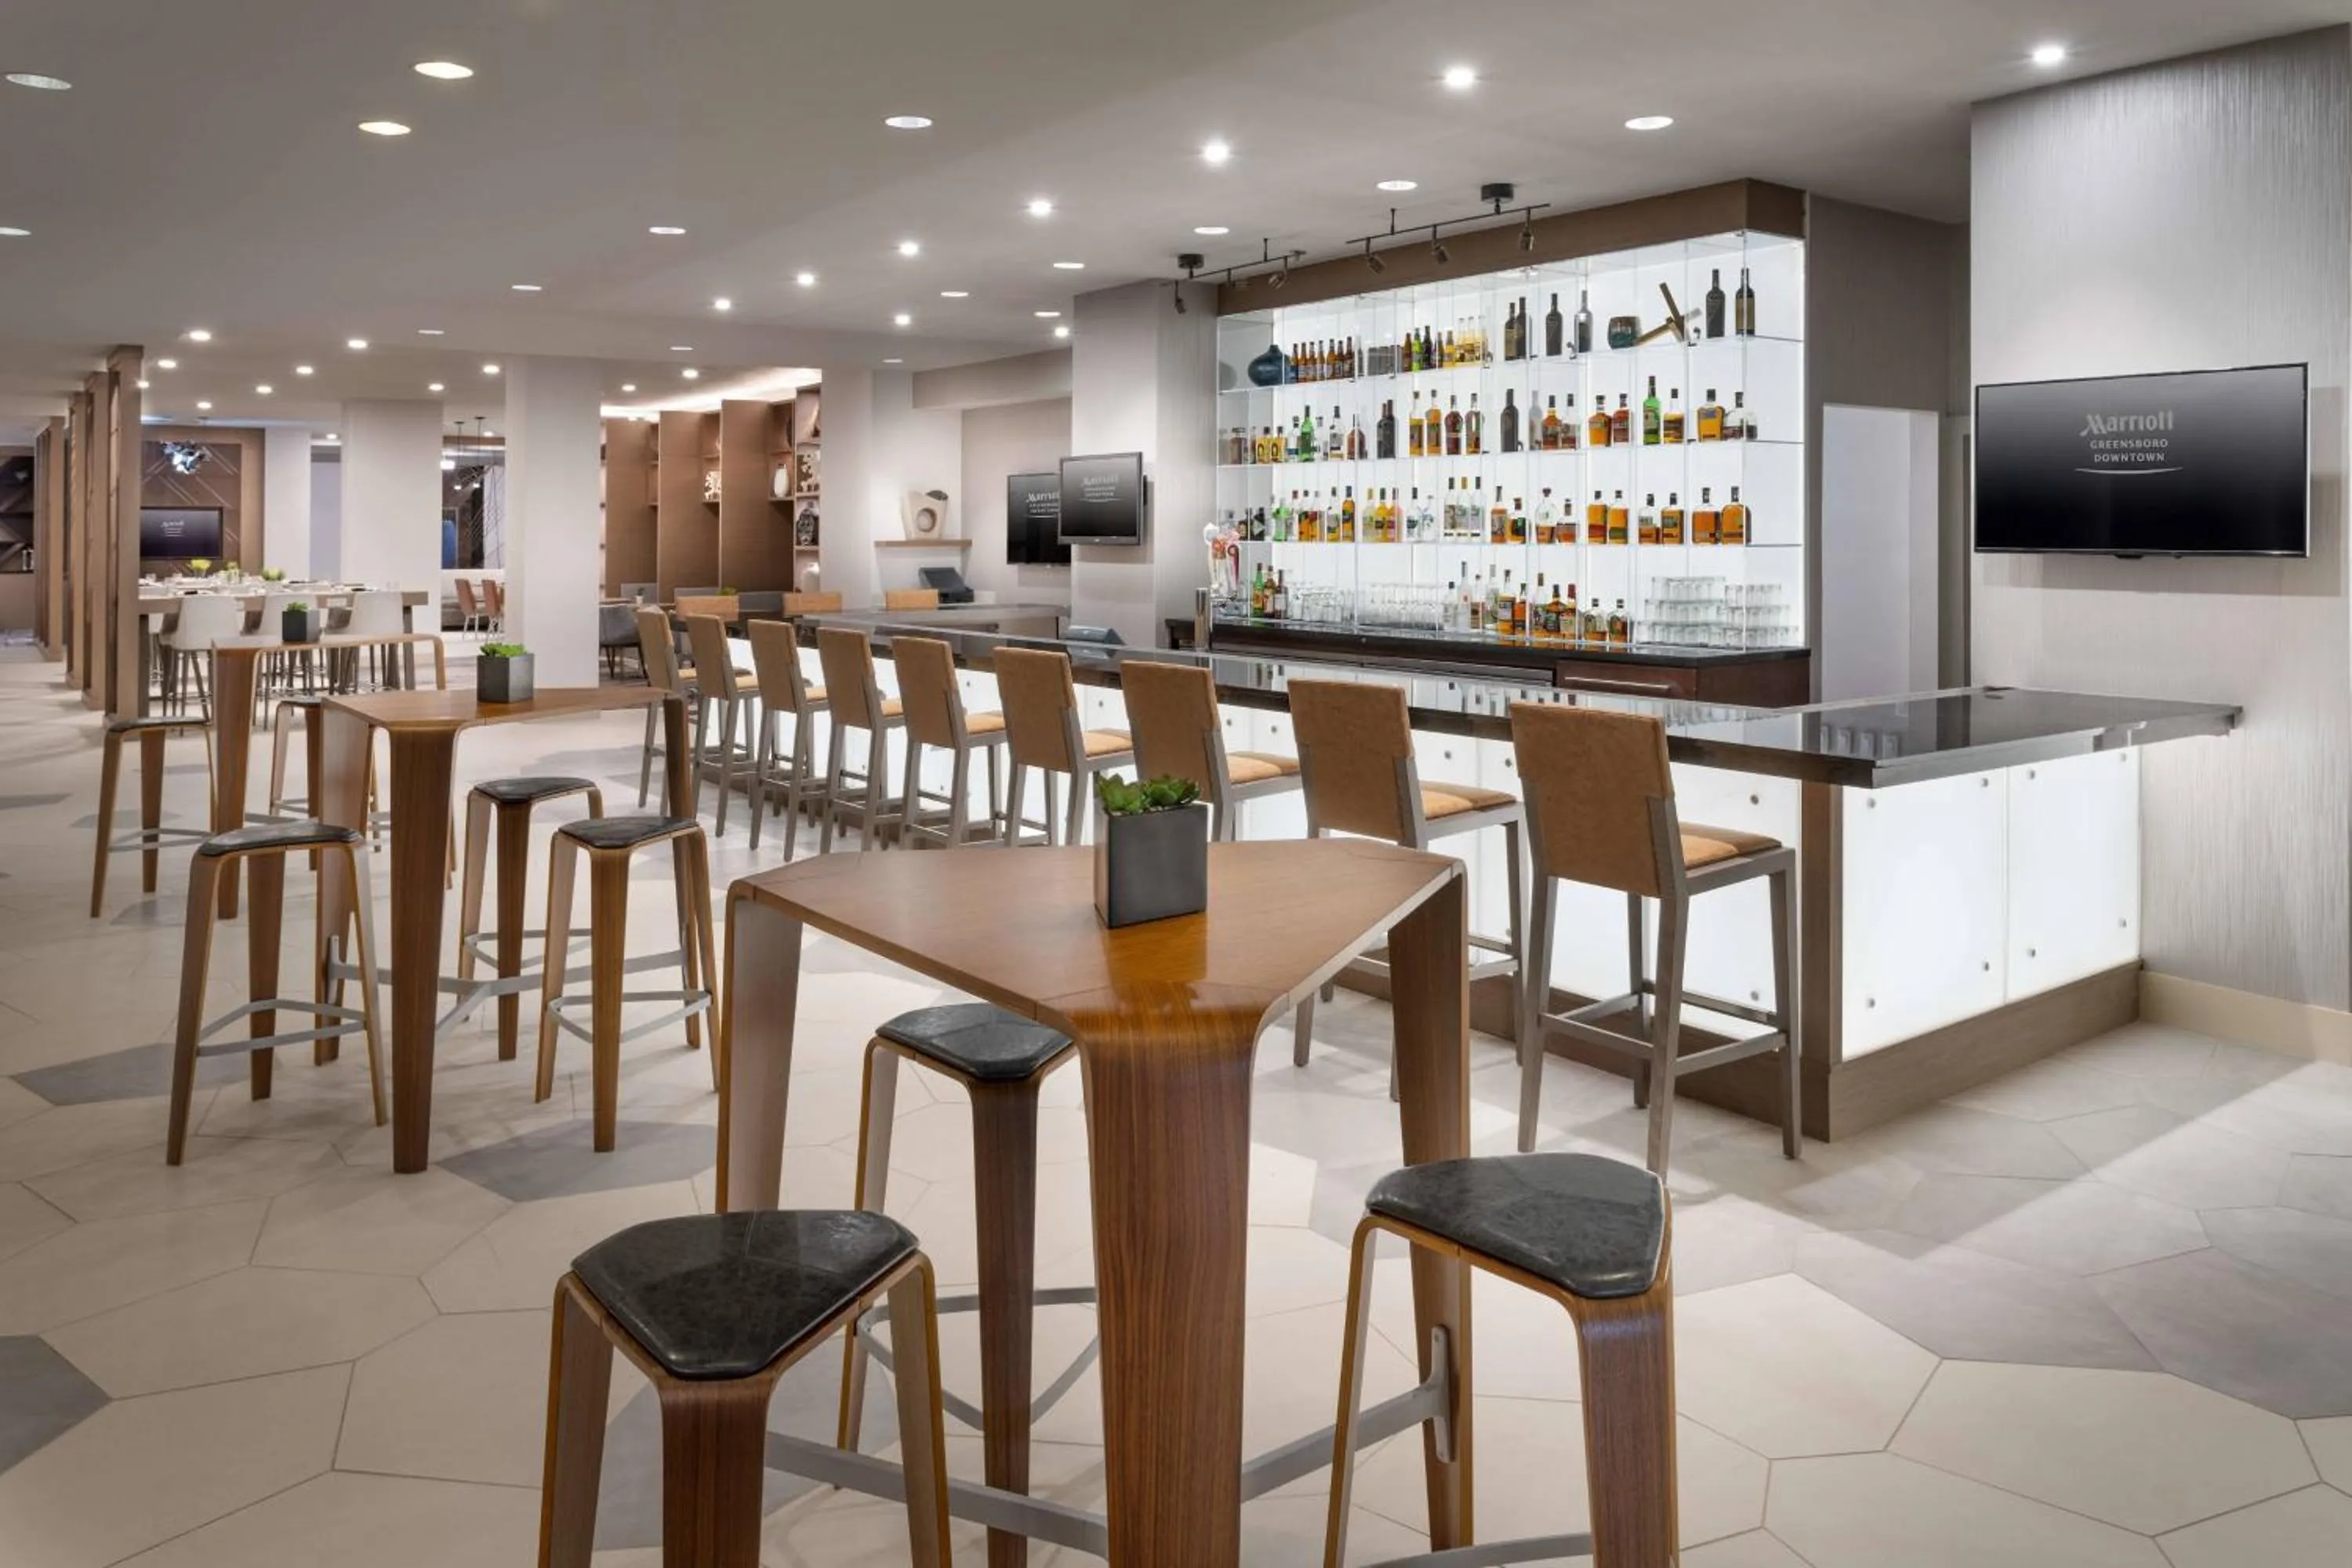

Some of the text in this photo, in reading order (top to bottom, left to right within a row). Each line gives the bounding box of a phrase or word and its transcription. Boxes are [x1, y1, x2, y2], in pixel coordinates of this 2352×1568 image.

[2079, 410, 2173, 437] Marriott
[2089, 438, 2169, 449] GREENSBORO
[2094, 452, 2165, 463] DOWNTOWN
